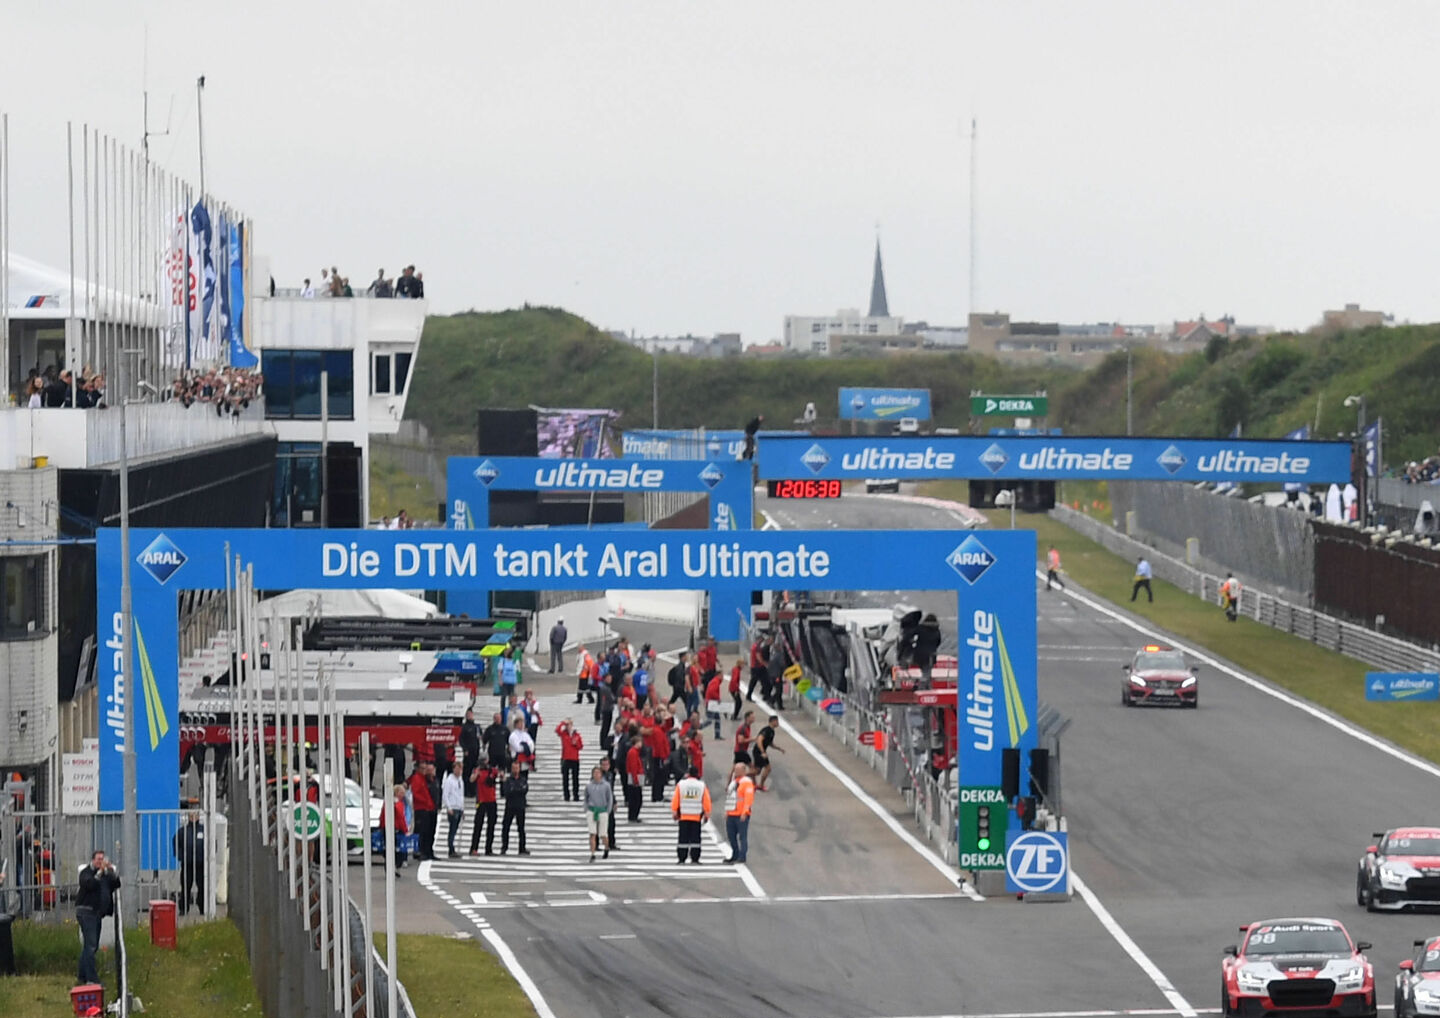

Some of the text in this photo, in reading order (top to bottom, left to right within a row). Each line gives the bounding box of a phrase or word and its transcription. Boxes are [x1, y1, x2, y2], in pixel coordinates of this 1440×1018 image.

[999, 400, 1034, 411] DEKRA
[842, 446, 955, 470] ultimate
[1019, 447, 1133, 471] ultimate
[1197, 450, 1310, 474] ultimate
[535, 462, 664, 488] ultimate
[776, 480, 841, 498] 12:06:38
[142, 543, 991, 577] ARAL Die DTM tankt Aral Ultimate ARAL
[967, 609, 993, 750] ultimate
[961, 790, 1004, 802] DEKRA
[961, 853, 1005, 866] DEKRA
[1014, 845, 1055, 878] ZF
[1250, 933, 1276, 945] 98
